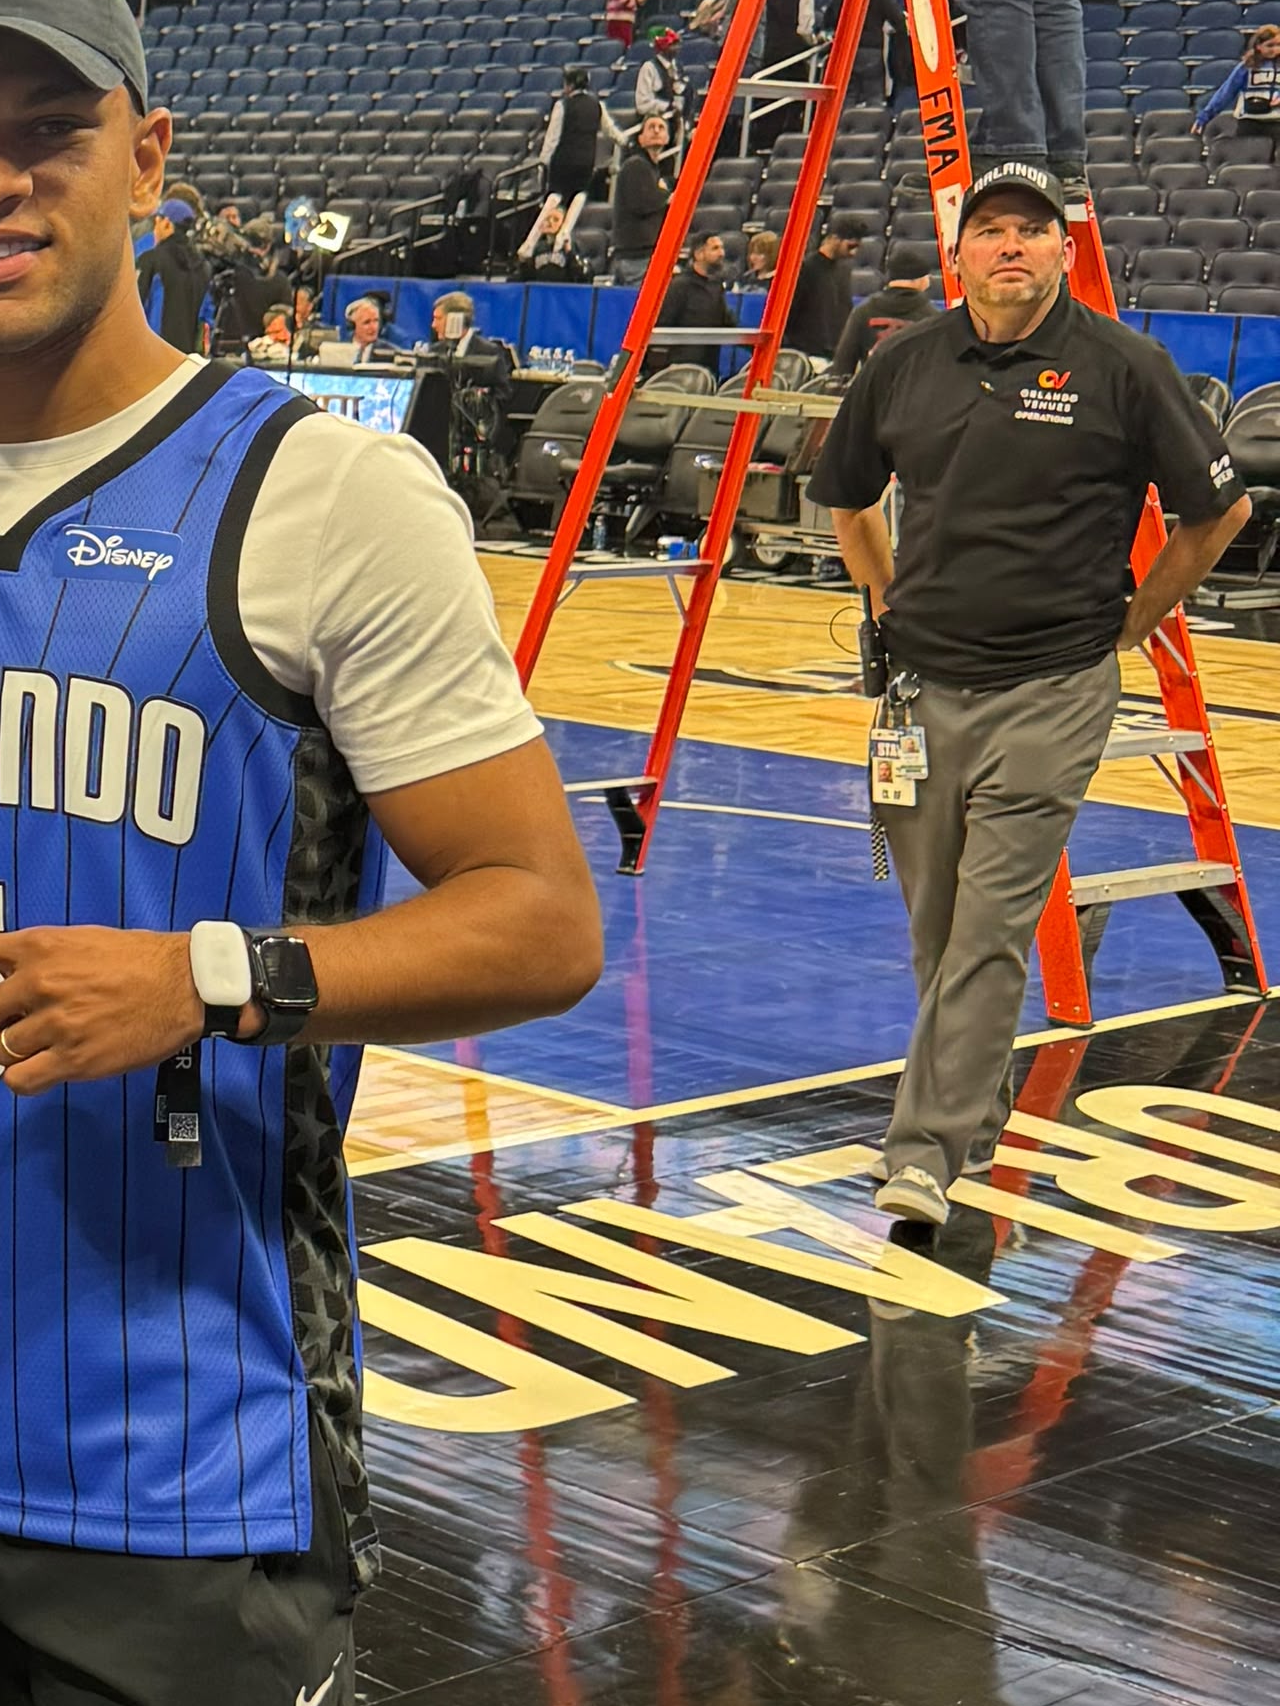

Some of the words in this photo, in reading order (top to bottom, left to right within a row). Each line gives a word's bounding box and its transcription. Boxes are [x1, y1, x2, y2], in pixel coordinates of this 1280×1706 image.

[919, 86, 961, 177] FMA
[973, 161, 1049, 195] ORLANDO
[1019, 388, 1079, 403] ORLANDO
[1022, 399, 1072, 414] VENUES
[877, 741, 901, 758] STA
[360, 1085, 1280, 1434] ORLAND
